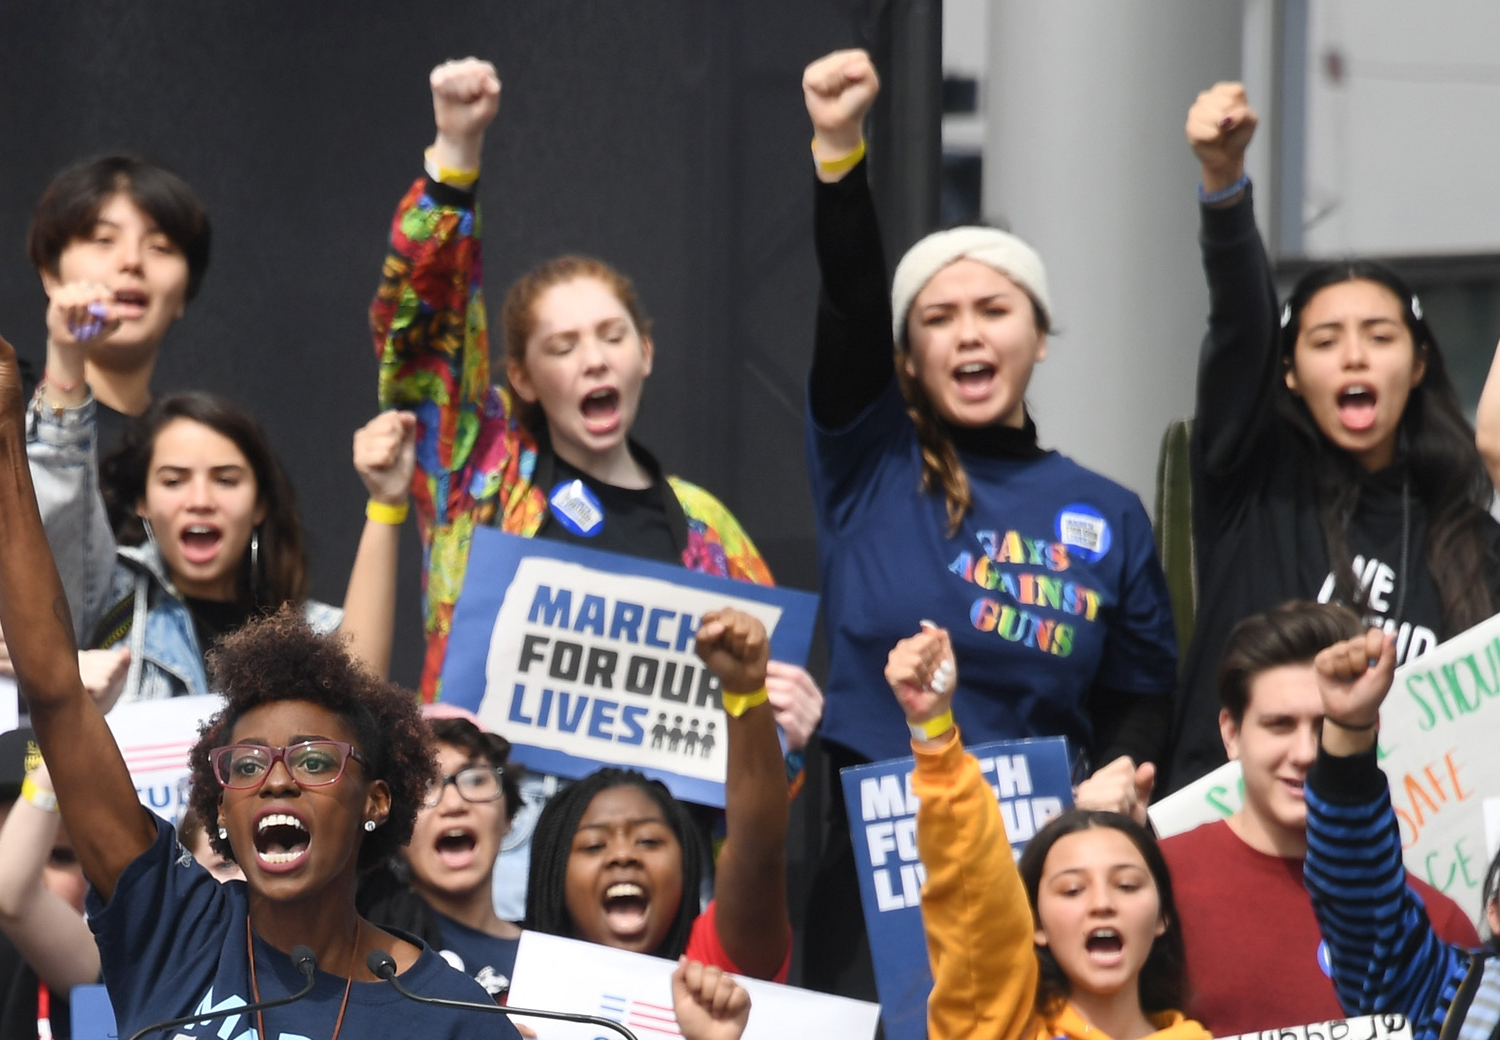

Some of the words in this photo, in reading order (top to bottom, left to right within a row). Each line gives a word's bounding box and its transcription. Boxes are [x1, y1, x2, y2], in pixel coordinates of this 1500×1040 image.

[527, 584, 706, 653] MARCH
[948, 550, 1103, 622] AGAINST
[970, 597, 1074, 658] GUNS
[518, 634, 618, 690] FOR
[508, 683, 648, 746] LIVES
[860, 754, 1032, 822] MCH
